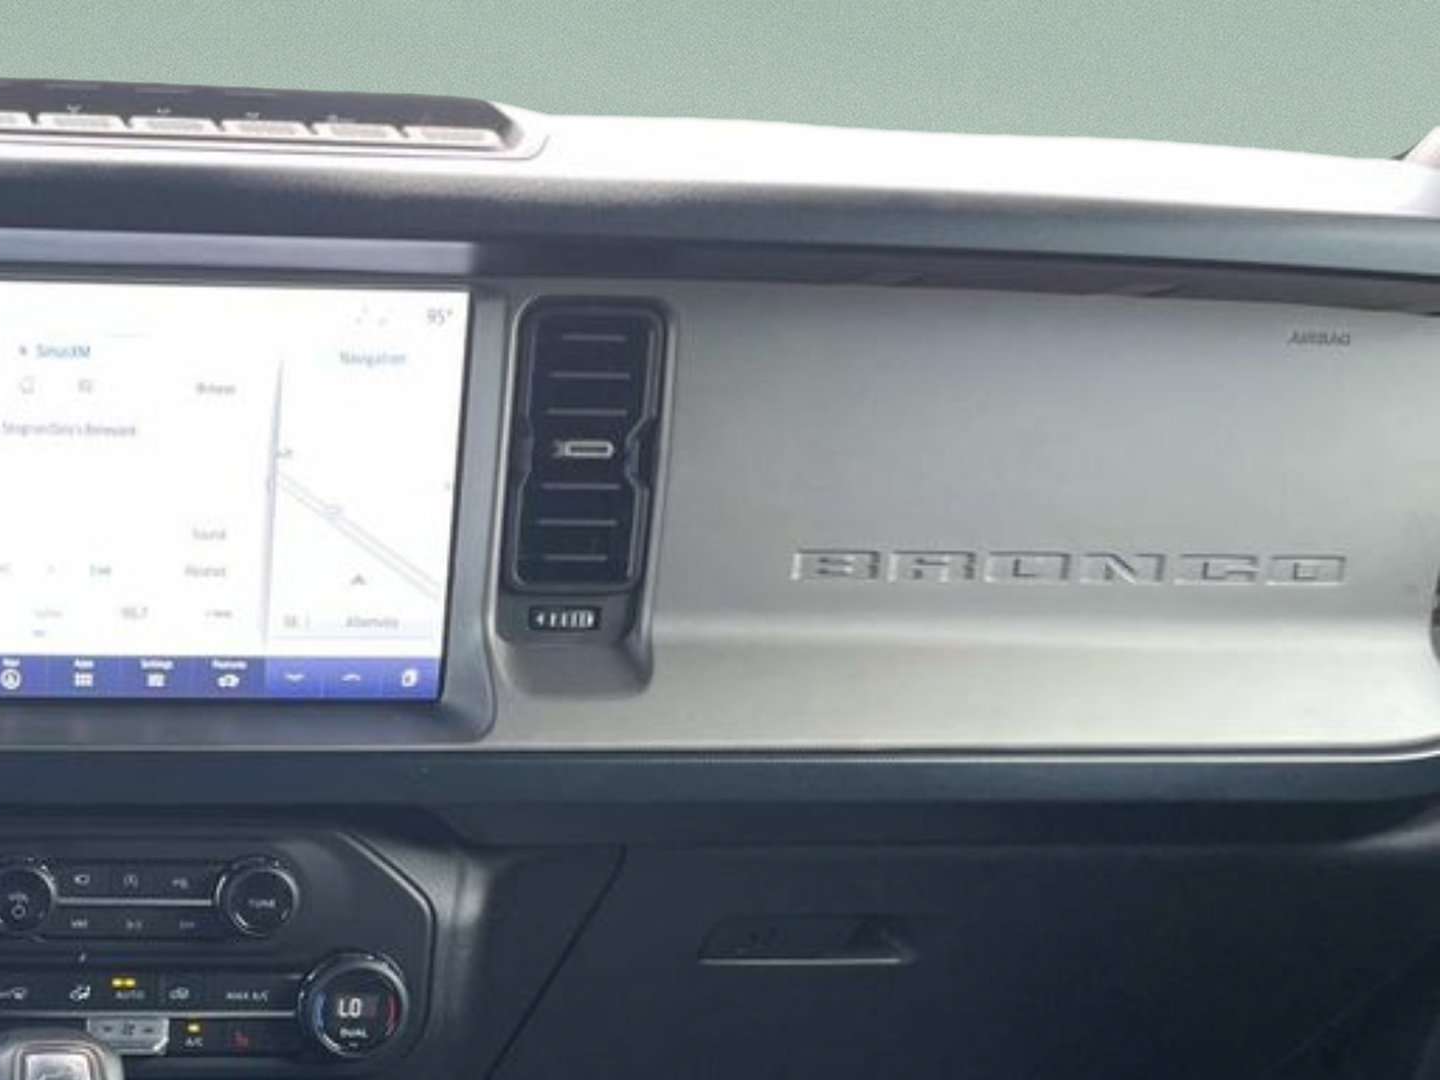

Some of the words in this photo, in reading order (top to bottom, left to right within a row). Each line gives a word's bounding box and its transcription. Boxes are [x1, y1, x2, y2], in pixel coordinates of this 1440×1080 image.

[339, 350, 406, 368] Navigation
[790, 548, 1347, 586] BRONCO
[140, 660, 173, 671] Settings
[338, 997, 362, 1018] LO
